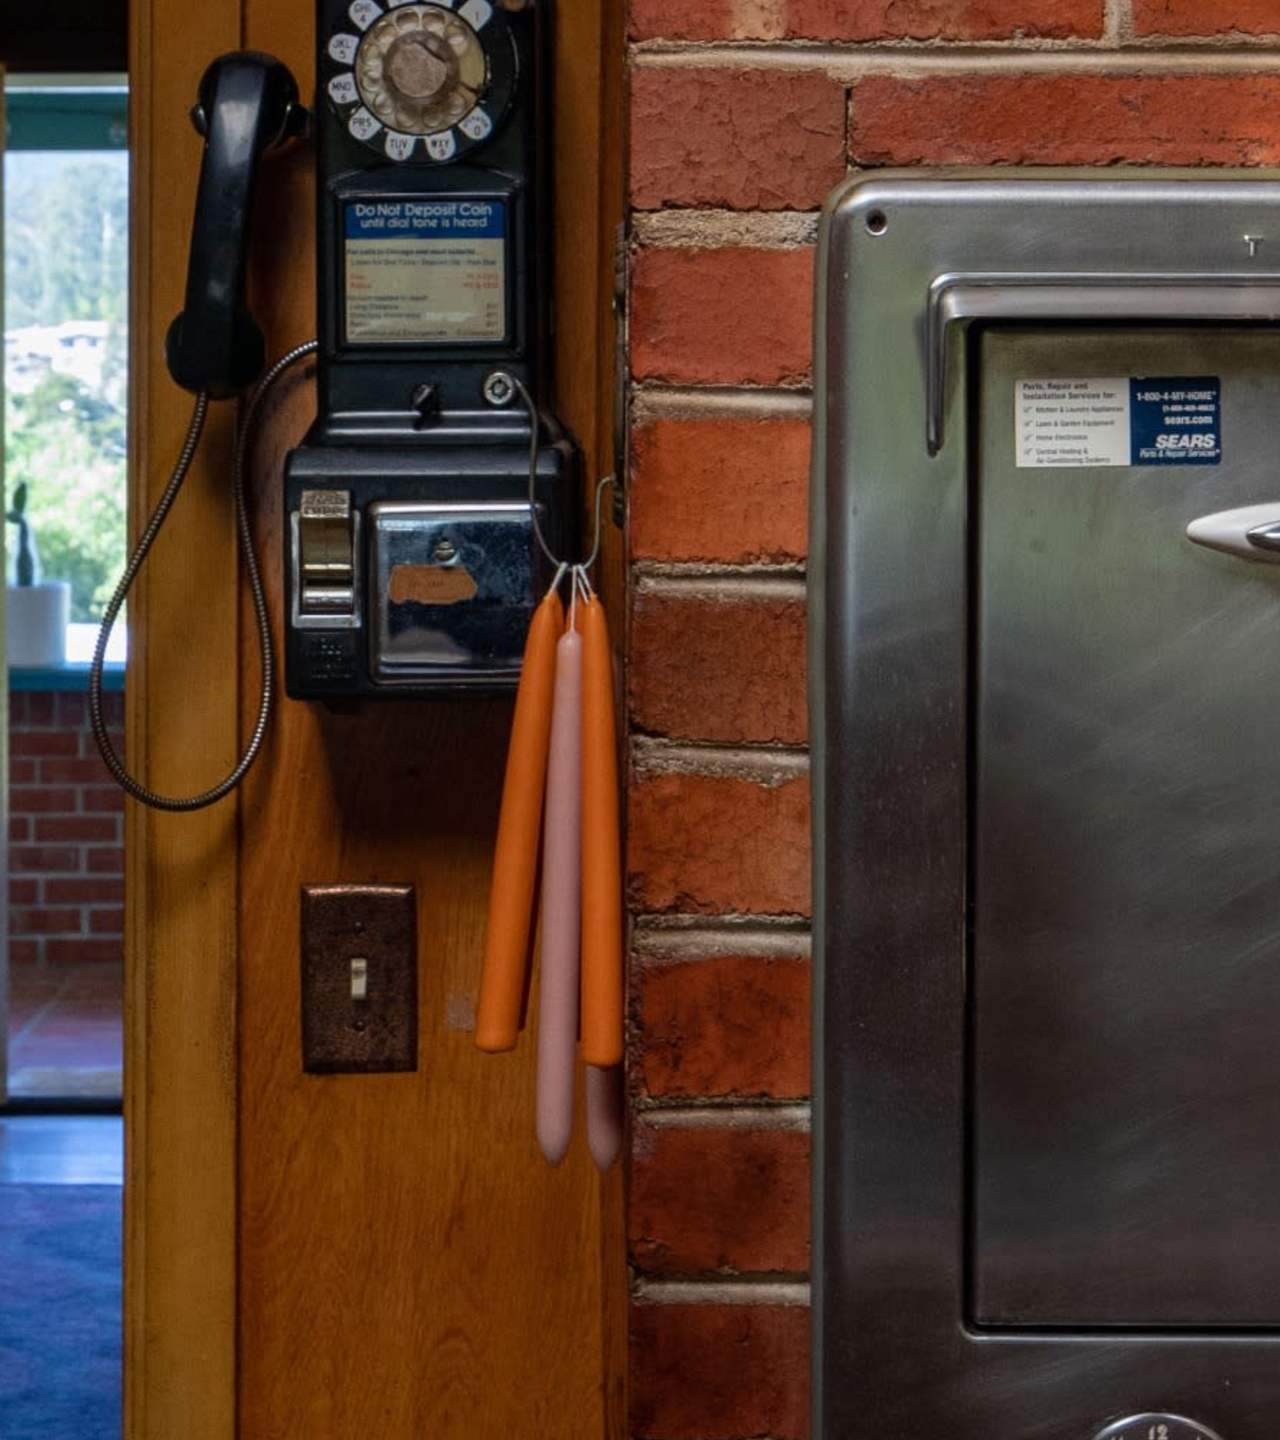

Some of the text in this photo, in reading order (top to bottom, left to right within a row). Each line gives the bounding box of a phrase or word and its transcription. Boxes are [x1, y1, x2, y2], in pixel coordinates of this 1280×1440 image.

[359, 15, 366, 23] 4
[332, 39, 351, 49] JKL
[390, 138, 408, 149] TUV
[431, 138, 450, 149] WXY
[355, 202, 493, 218] Do Not Deposit Coin
[360, 217, 488, 228] until dial tone is heard
[1047, 383, 1072, 391] Repair
[1023, 392, 1066, 400] Installation
[1068, 392, 1100, 400] Services
[1164, 416, 1213, 425] sears.com
[1155, 433, 1216, 449] SEARS
[1148, 1423, 1169, 1440] 12
